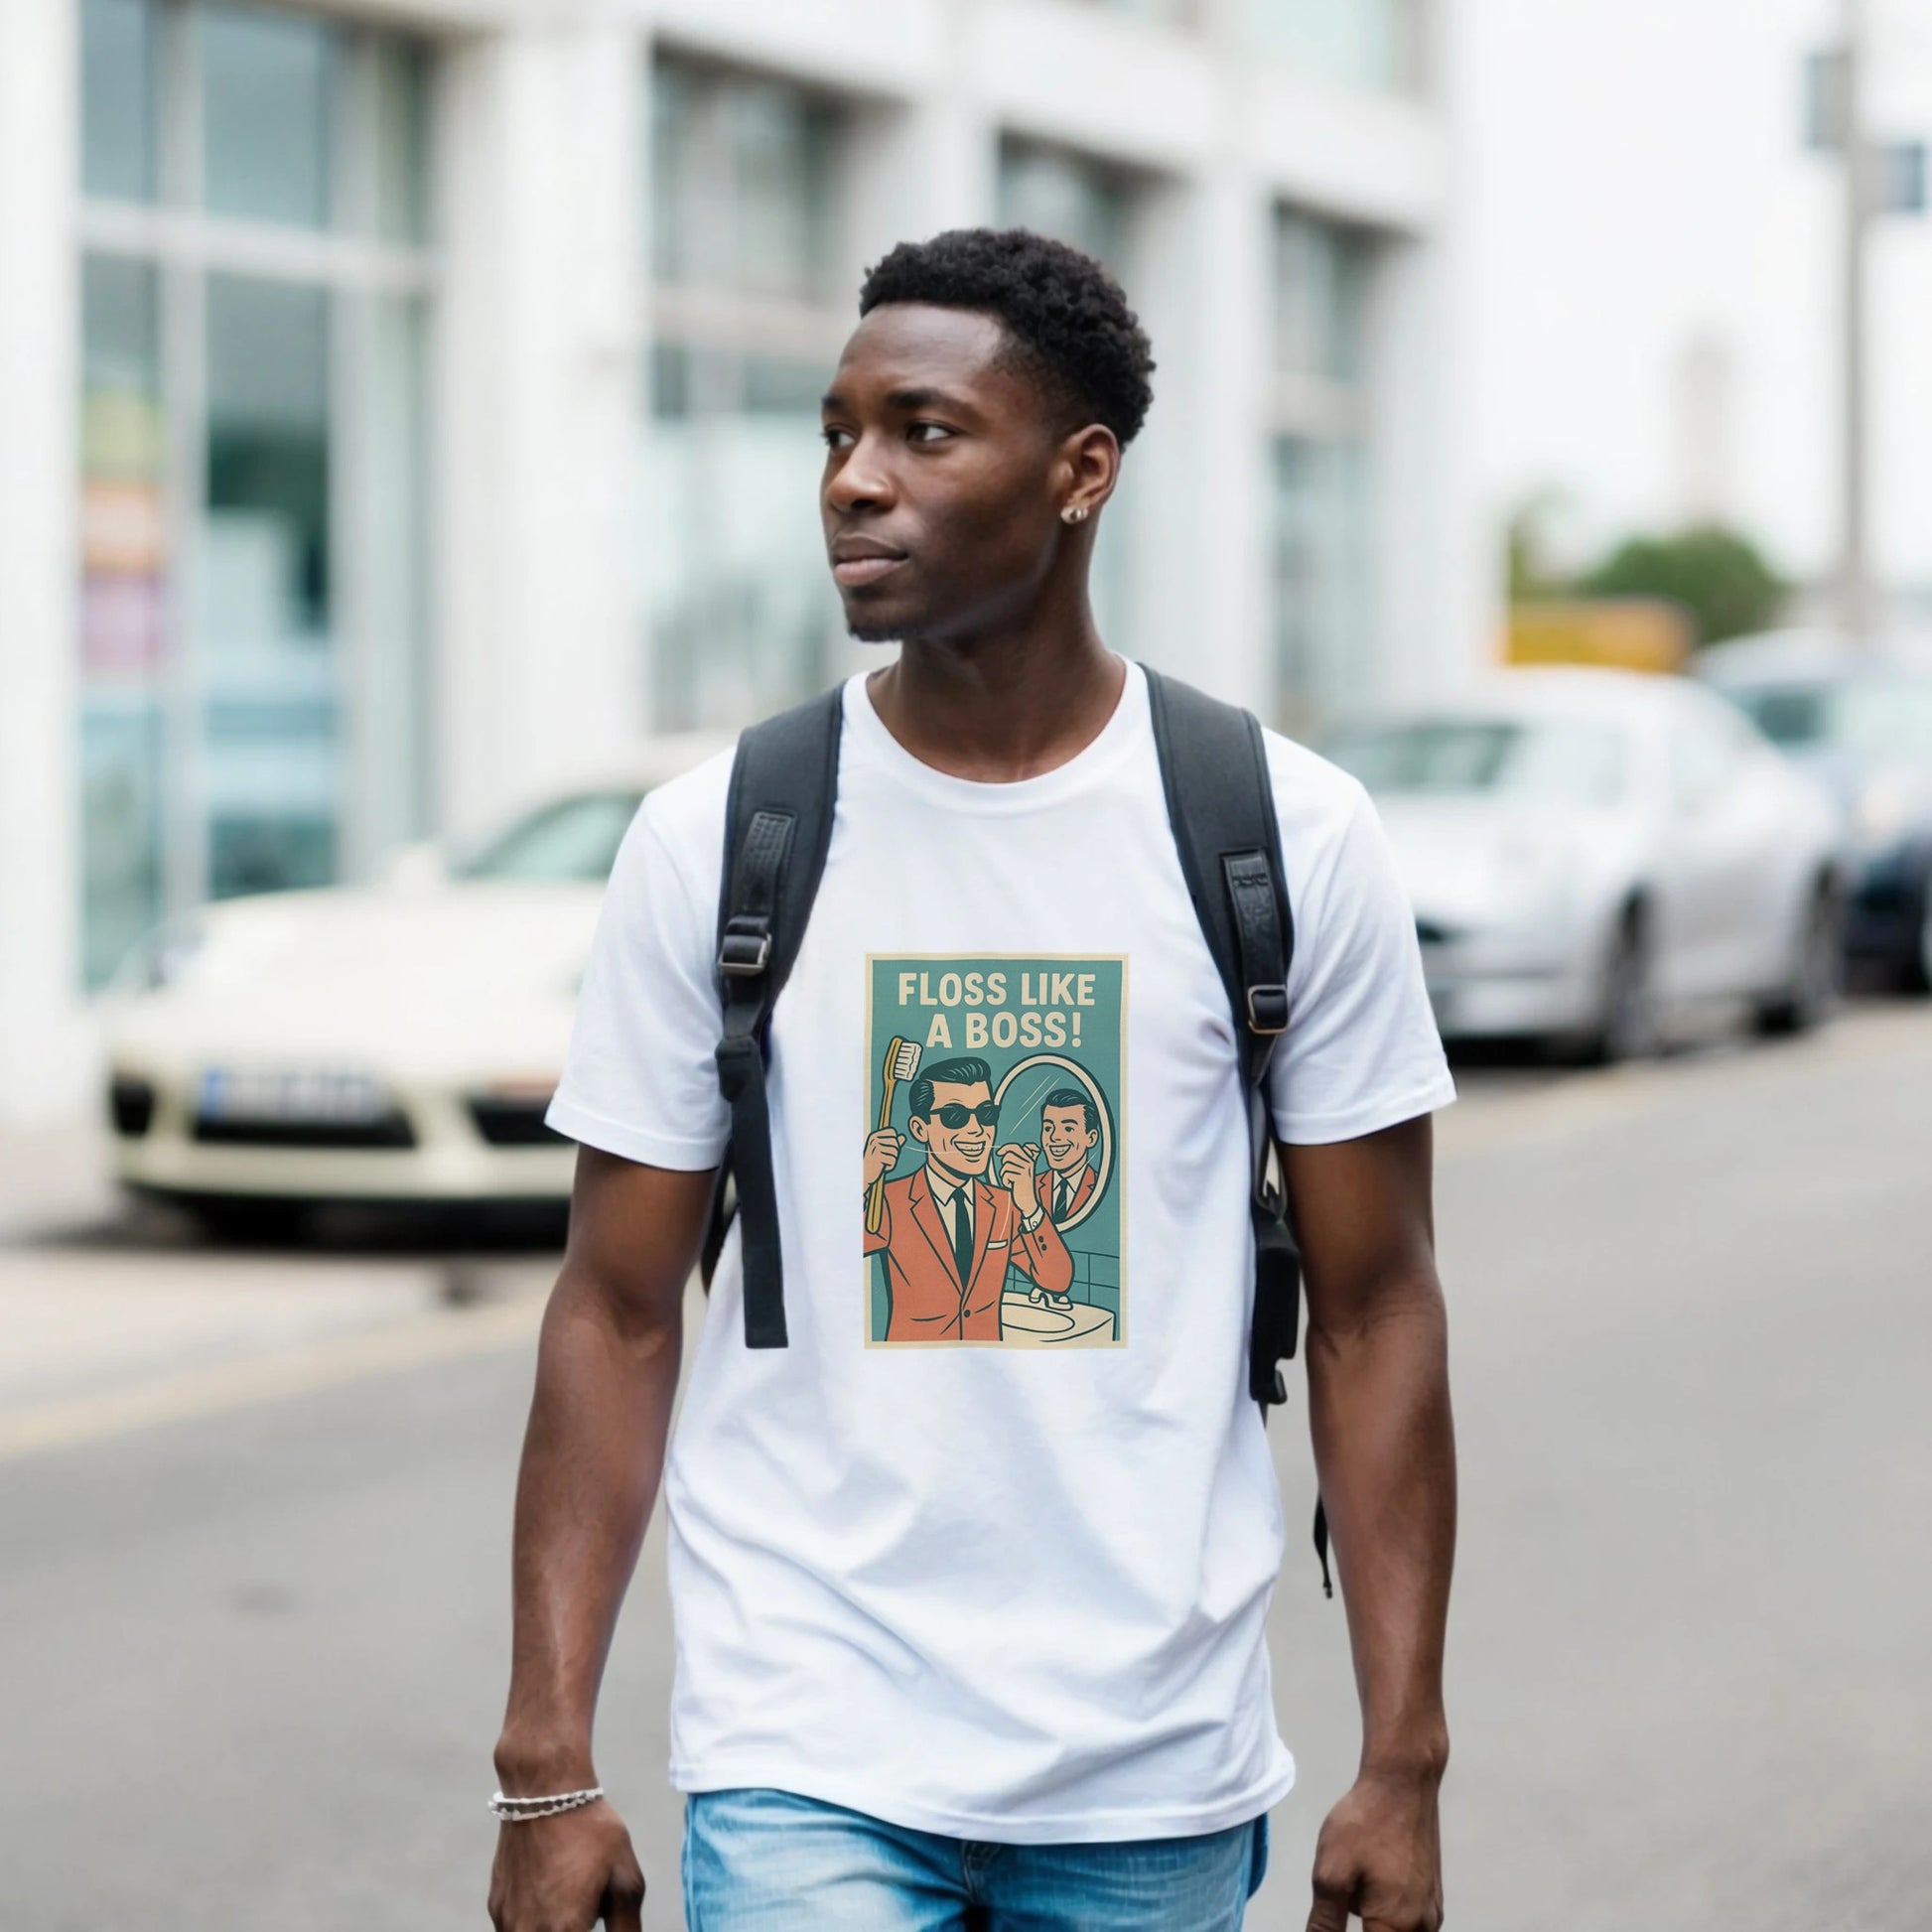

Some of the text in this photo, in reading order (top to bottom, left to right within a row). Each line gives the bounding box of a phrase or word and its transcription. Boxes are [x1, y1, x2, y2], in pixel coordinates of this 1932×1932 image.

[898, 972, 1096, 1007] FLOSS LIKE
[925, 1012, 1082, 1048] A BOSS!
